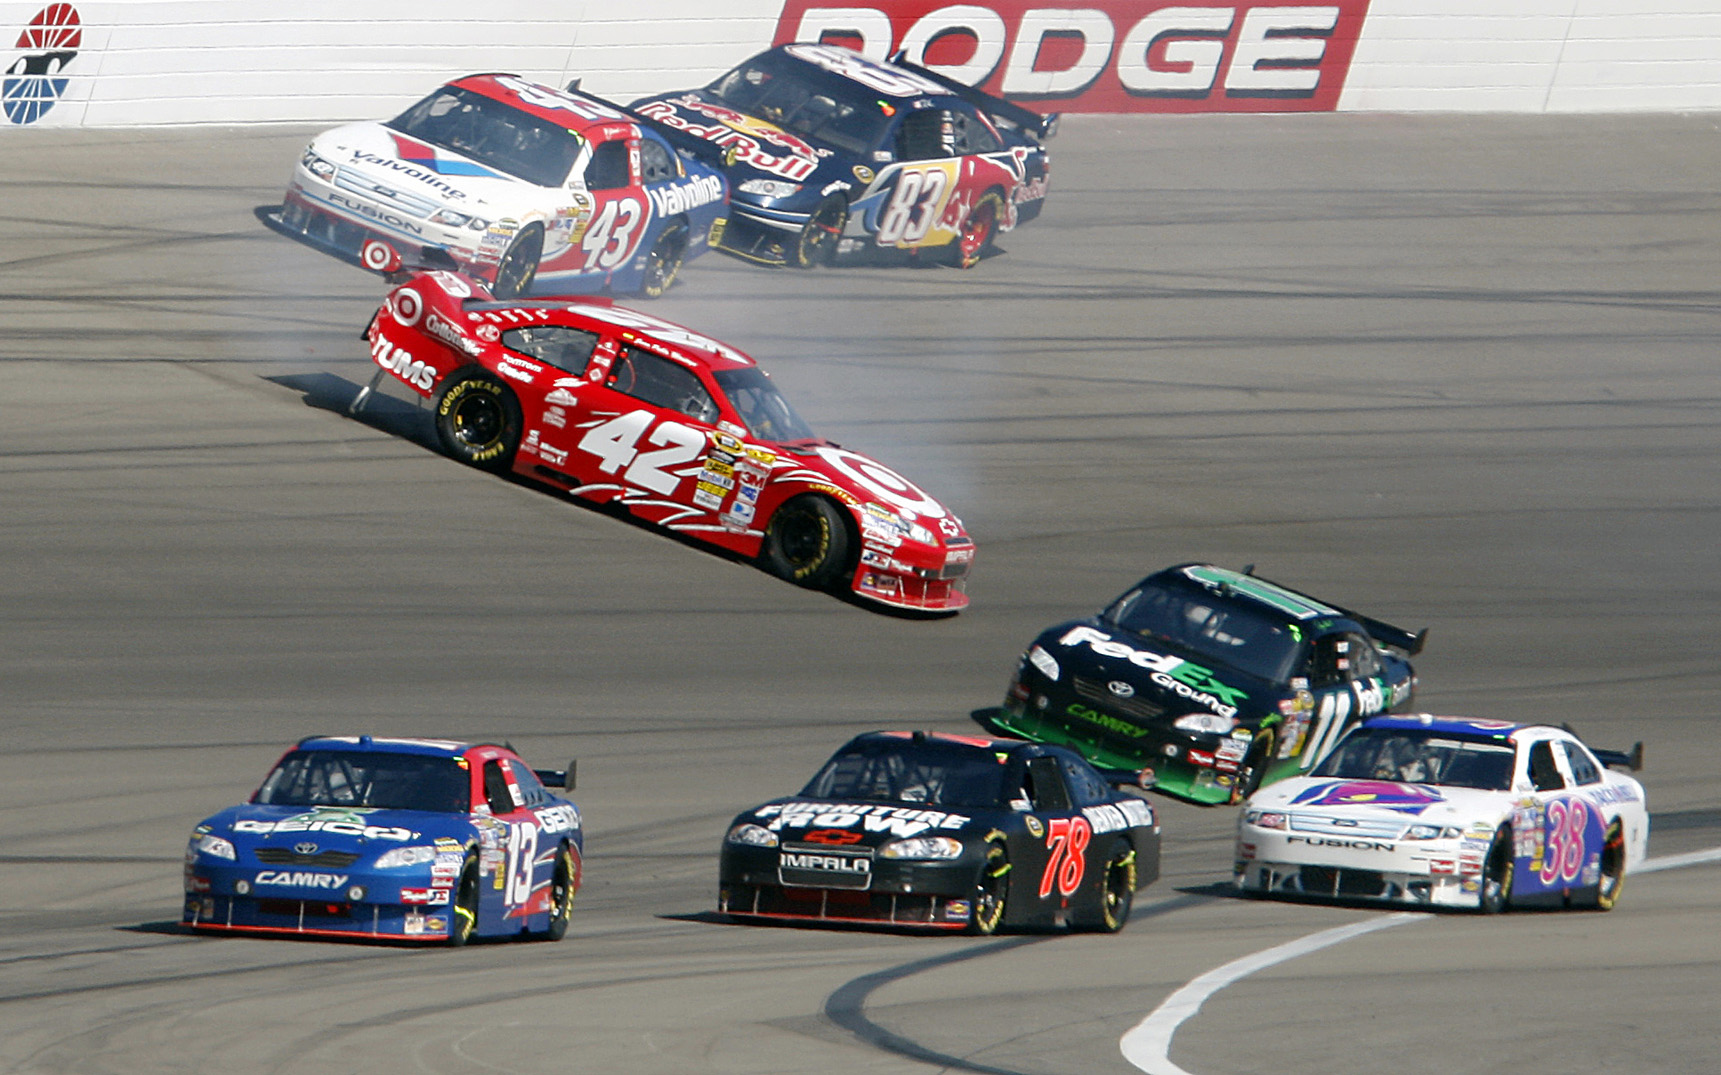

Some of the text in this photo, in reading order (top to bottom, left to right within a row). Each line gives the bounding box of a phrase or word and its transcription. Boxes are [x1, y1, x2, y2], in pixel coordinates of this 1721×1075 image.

[796, 4, 1339, 97] DODGE
[353, 150, 467, 199] Valvoline
[650, 175, 722, 218] Valvoline
[328, 193, 423, 234] FUSION
[877, 167, 948, 247] 83
[583, 198, 641, 270] 43
[371, 332, 438, 390] TUMS
[577, 409, 706, 496] 42
[1151, 672, 1238, 719] Ground
[1065, 703, 1149, 738] CAMRY
[1300, 690, 1351, 770] 11
[754, 802, 971, 830] FURNITURE
[767, 812, 931, 839] ROW
[504, 821, 539, 906] 13
[780, 853, 871, 873] IMPALA
[1040, 815, 1092, 898] 78
[1286, 836, 1396, 852] FUSION
[1540, 798, 1588, 886] 38
[255, 870, 354, 890] CAMRY
